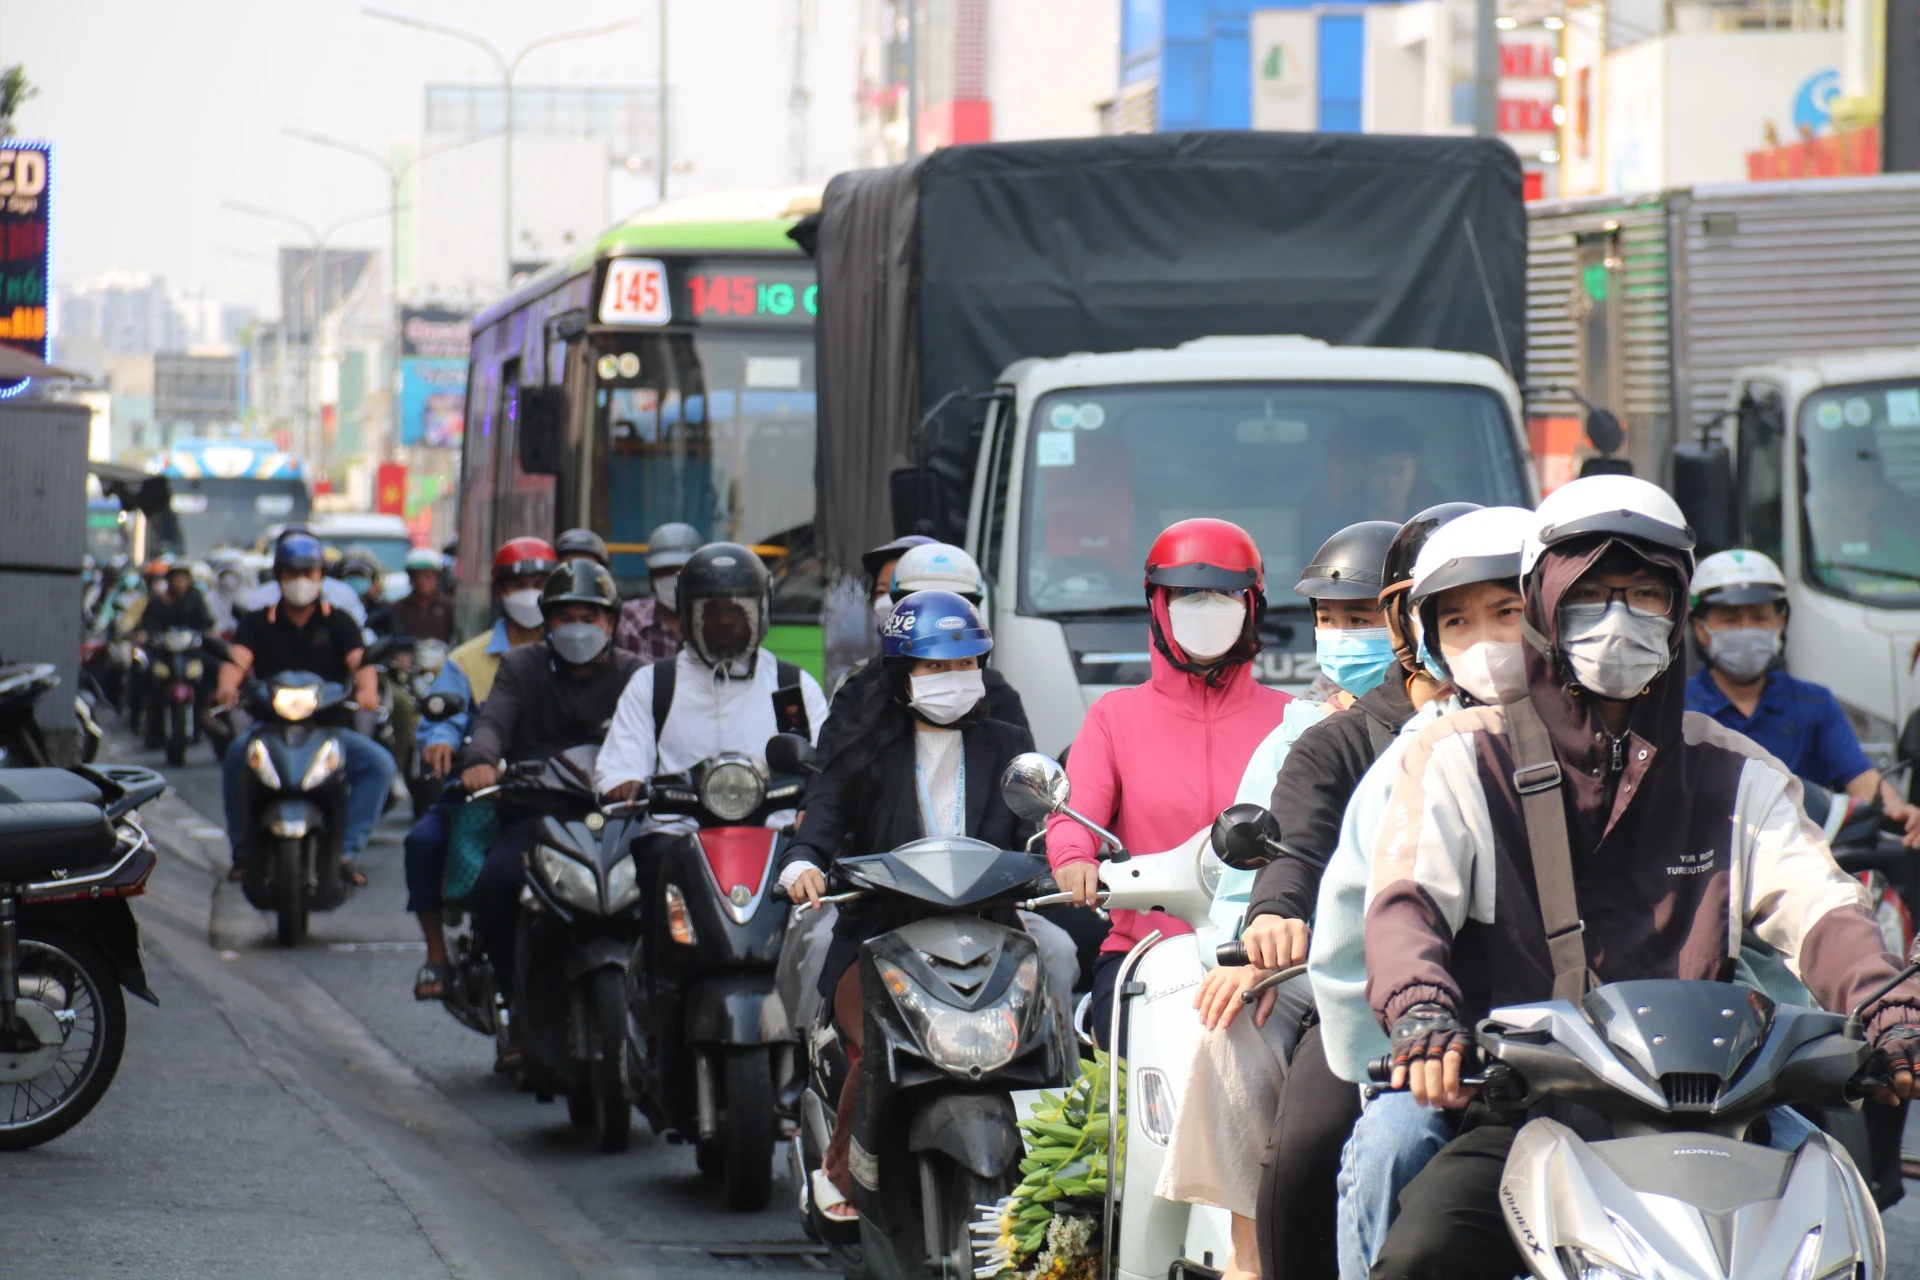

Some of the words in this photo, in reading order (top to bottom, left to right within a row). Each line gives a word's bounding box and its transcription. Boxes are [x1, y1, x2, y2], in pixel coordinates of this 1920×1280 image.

[613, 270, 660, 313] 145
[687, 275, 757, 317] 145
[1673, 1149, 1732, 1157] HONDA
